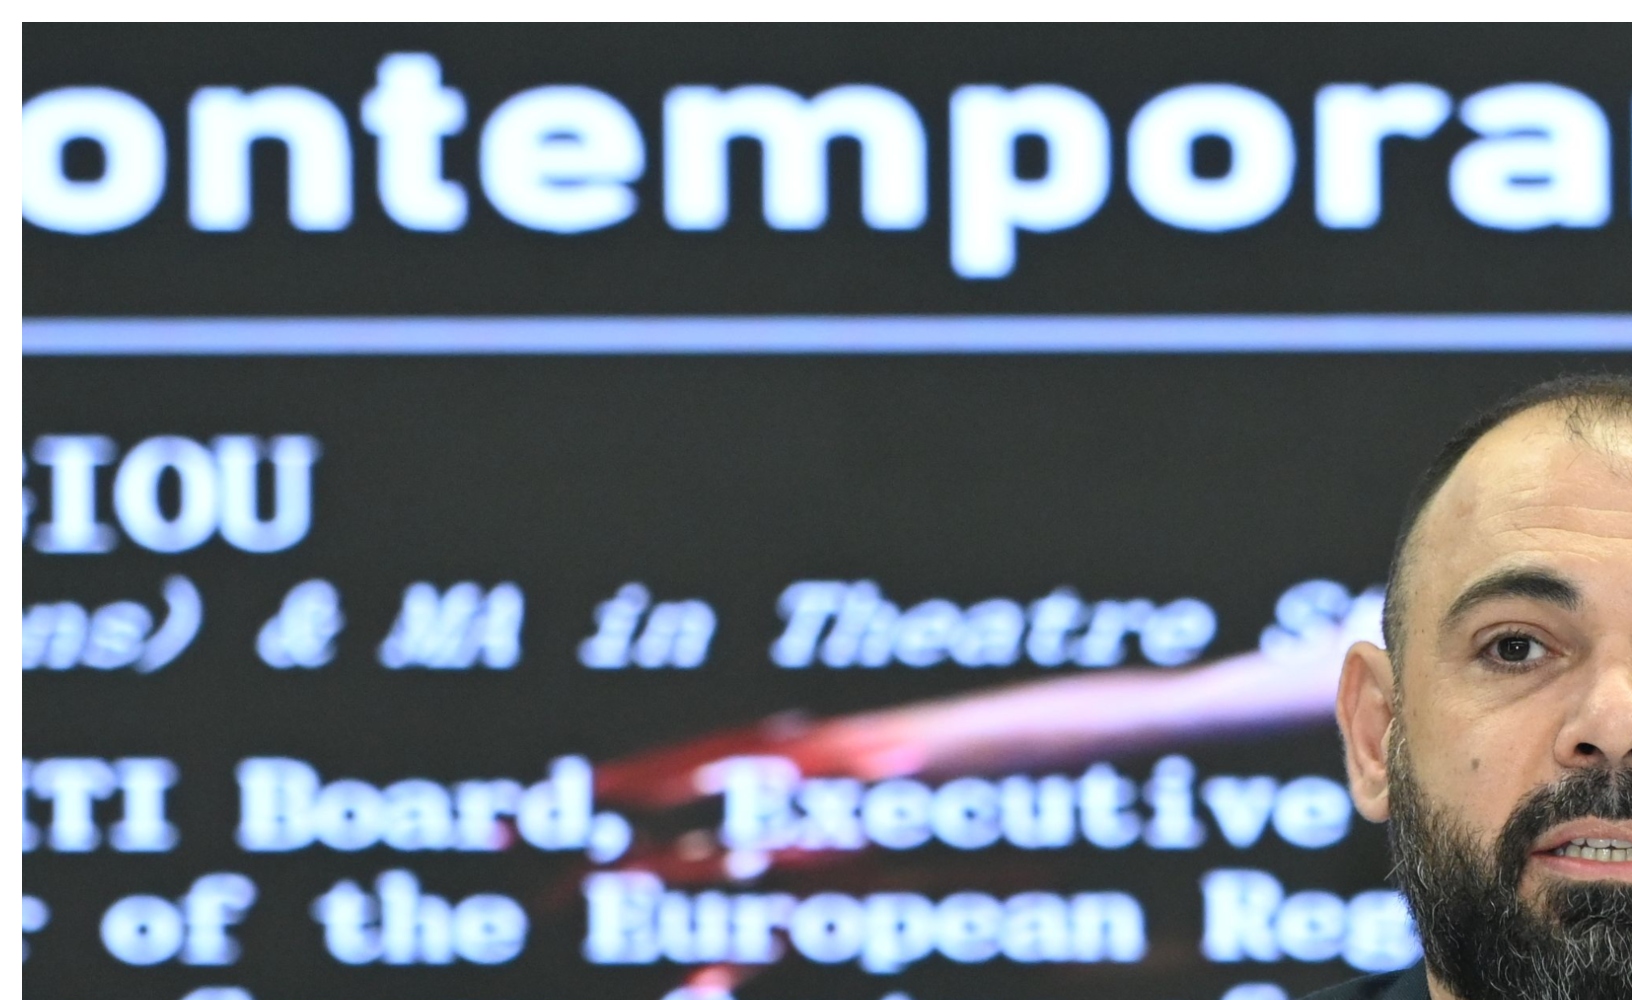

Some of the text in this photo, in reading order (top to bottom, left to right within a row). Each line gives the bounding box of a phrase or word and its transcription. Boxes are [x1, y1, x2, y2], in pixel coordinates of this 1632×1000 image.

[22, 433, 321, 554] IOU
[253, 578, 347, 670] &
[377, 581, 526, 670] MA
[577, 581, 718, 670] in
[769, 579, 1219, 669] Theatre
[235, 755, 633, 863] Board,
[714, 754, 1353, 850] Executive
[100, 871, 258, 966] of
[313, 868, 529, 966] the
[583, 870, 1148, 975] European
